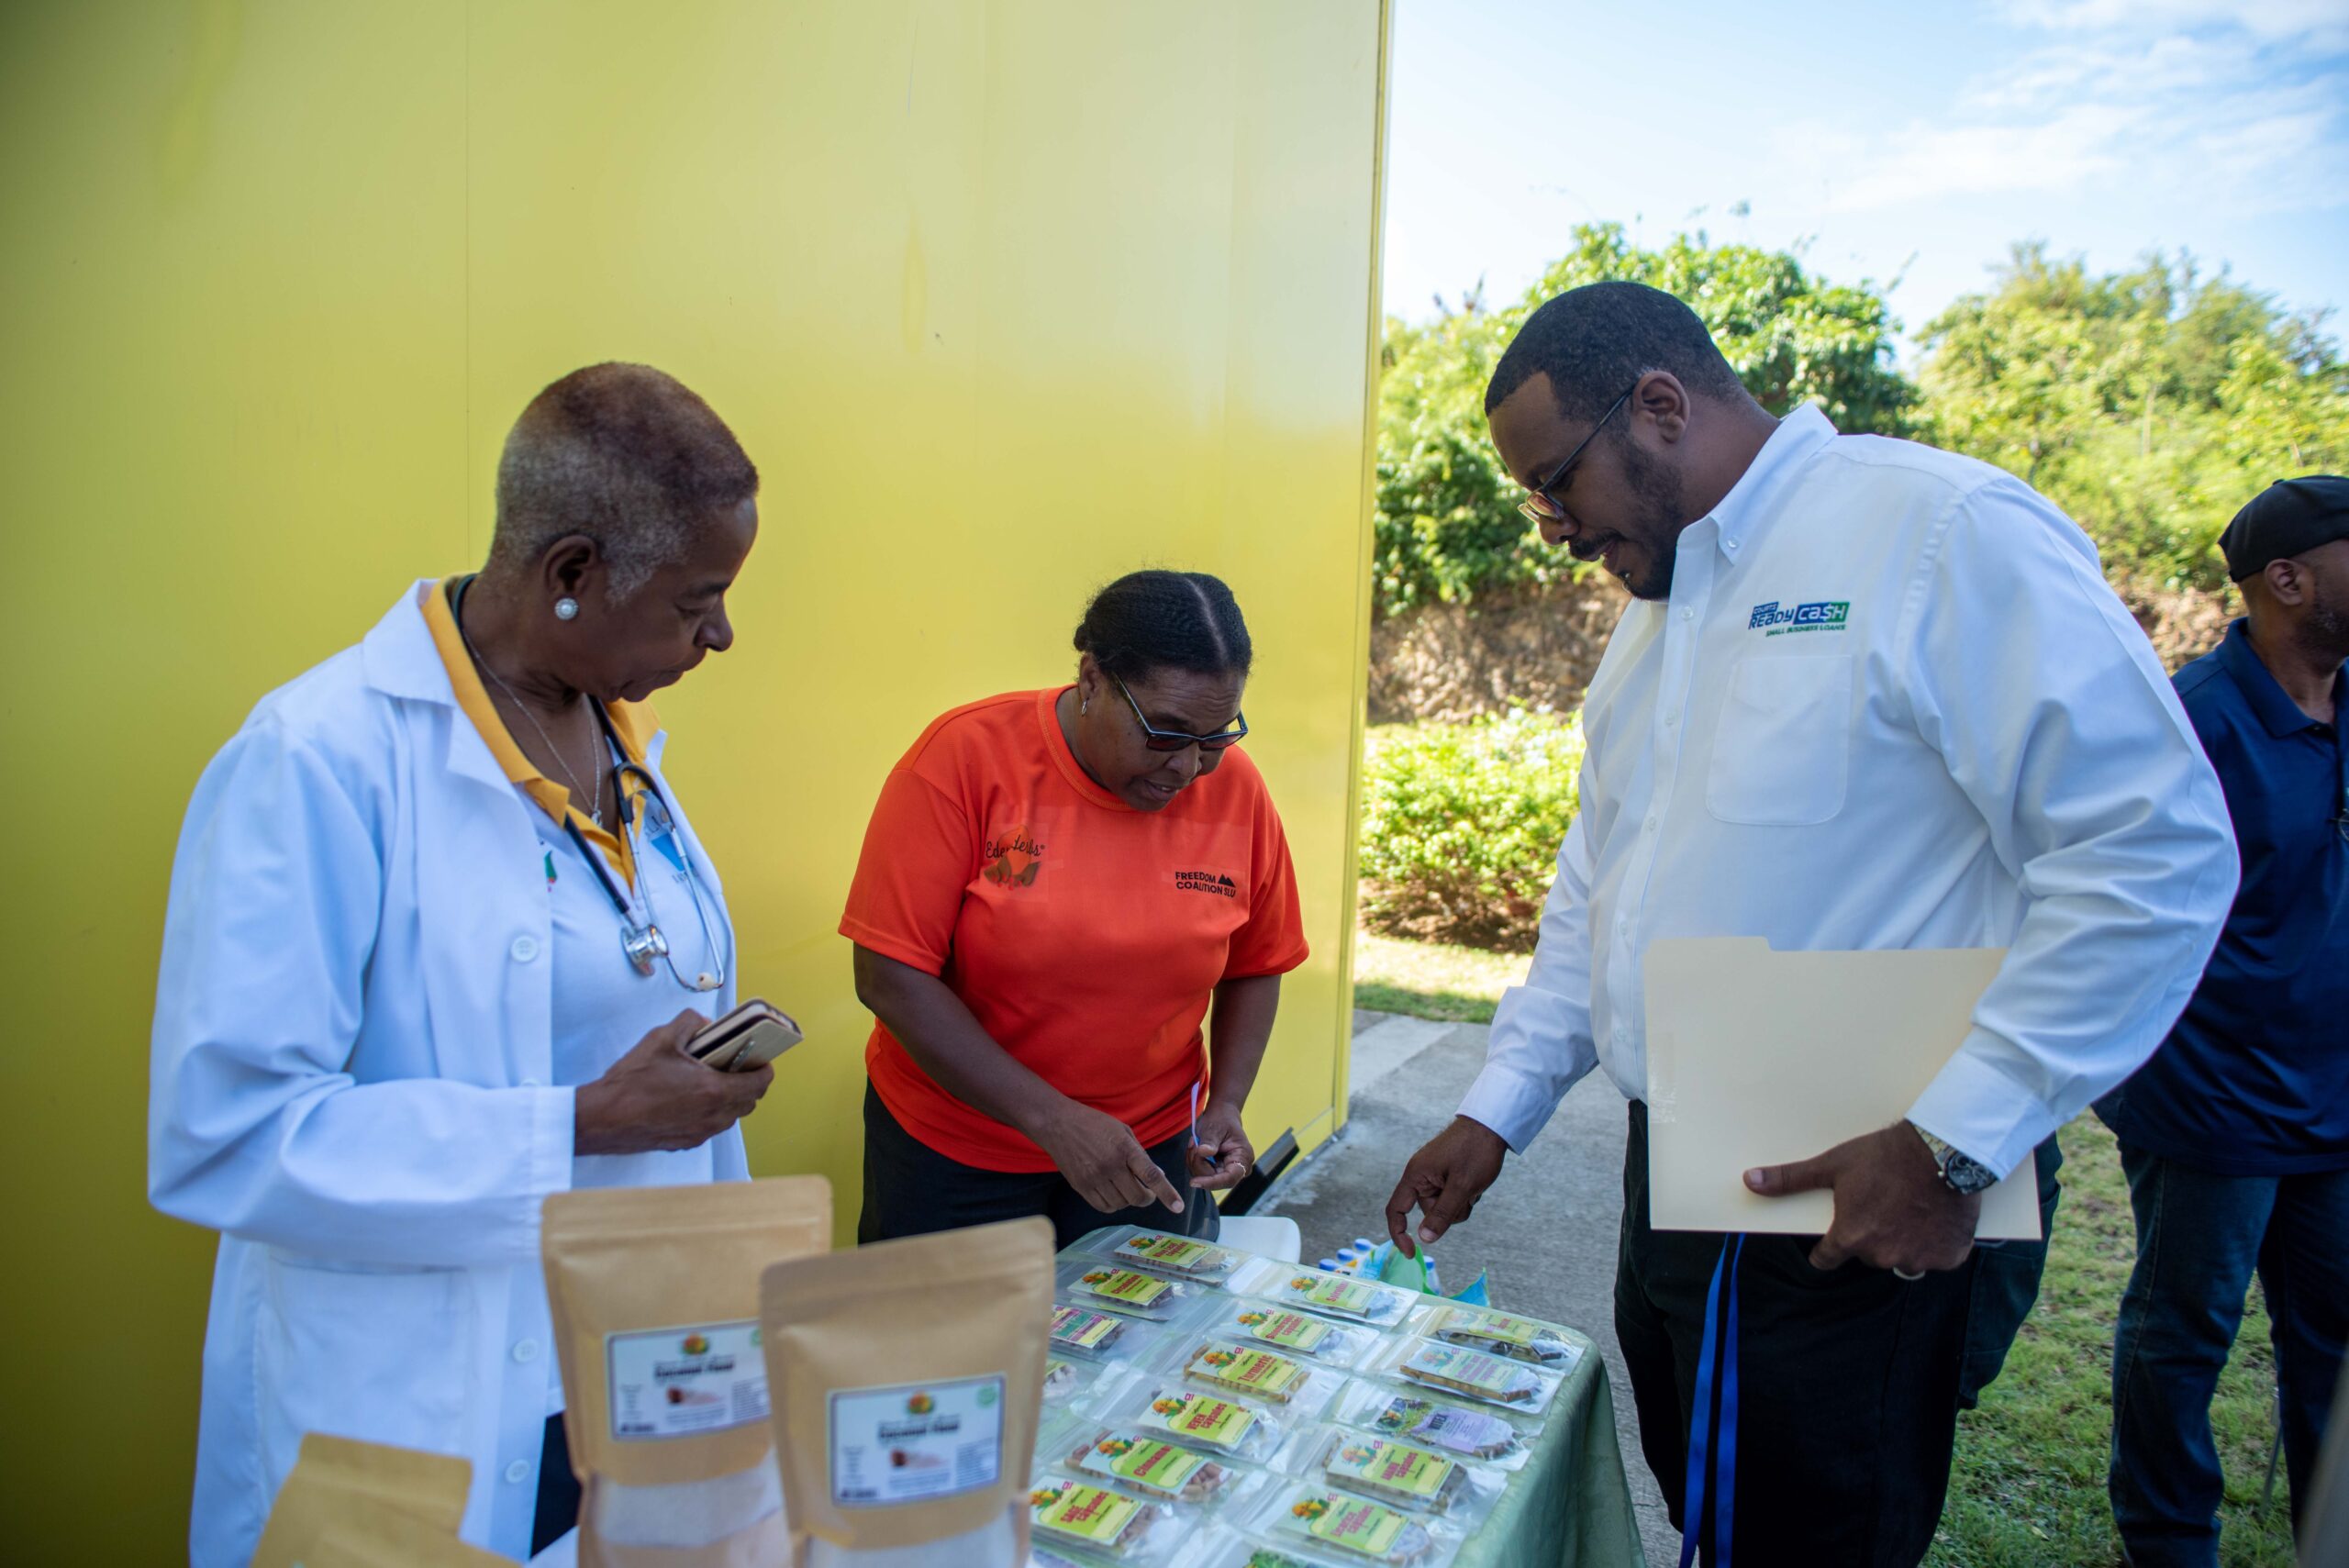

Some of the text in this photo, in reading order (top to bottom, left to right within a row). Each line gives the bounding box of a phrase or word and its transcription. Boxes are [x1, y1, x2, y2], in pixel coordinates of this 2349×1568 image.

[1765, 628, 1785, 638] SMALL
[1787, 625, 1819, 634] BUSINESS
[1174, 871, 1217, 884] FREEDOM
[1175, 881, 1236, 898] COALITION SLU
[1237, 1353, 1274, 1383] Turmeric
